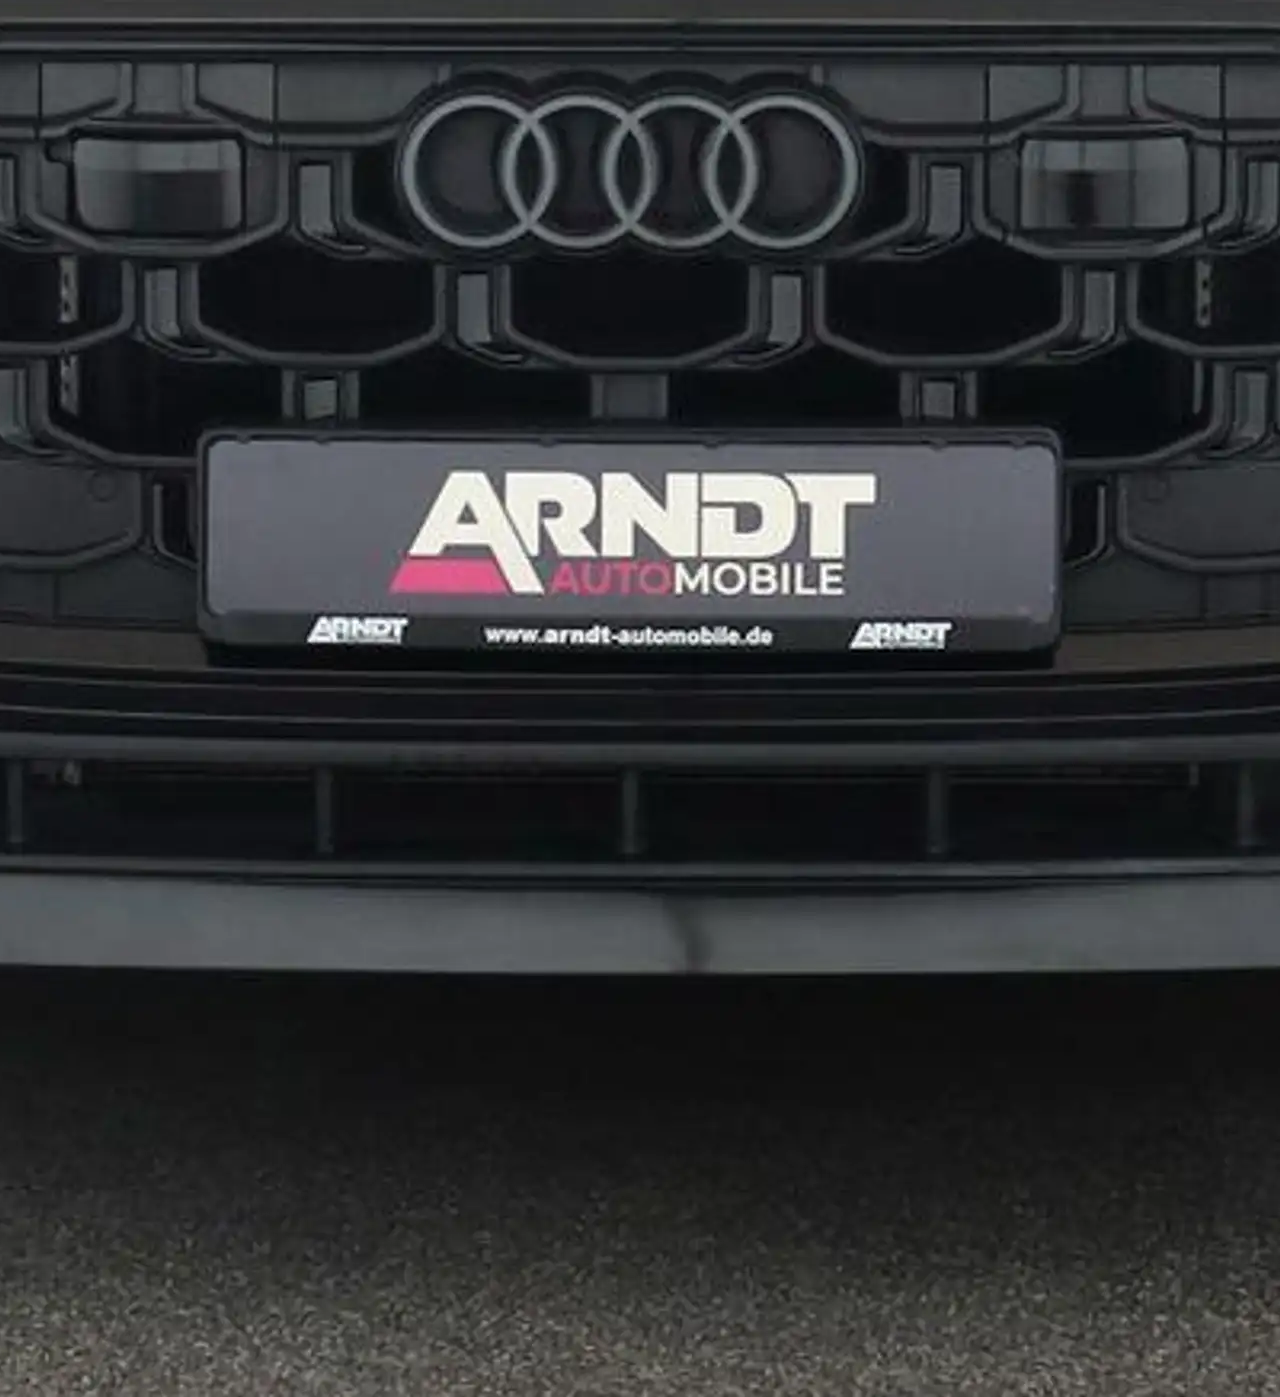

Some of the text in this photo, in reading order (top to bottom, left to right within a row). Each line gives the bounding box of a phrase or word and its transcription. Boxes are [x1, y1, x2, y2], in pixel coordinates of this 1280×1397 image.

[408, 470, 877, 595] ARNDT
[551, 560, 845, 596] AUTOMOBILE
[307, 616, 409, 643] ARNDT
[484, 625, 773, 645] www.arndt-automobile.de
[850, 622, 952, 649] ARNDT
